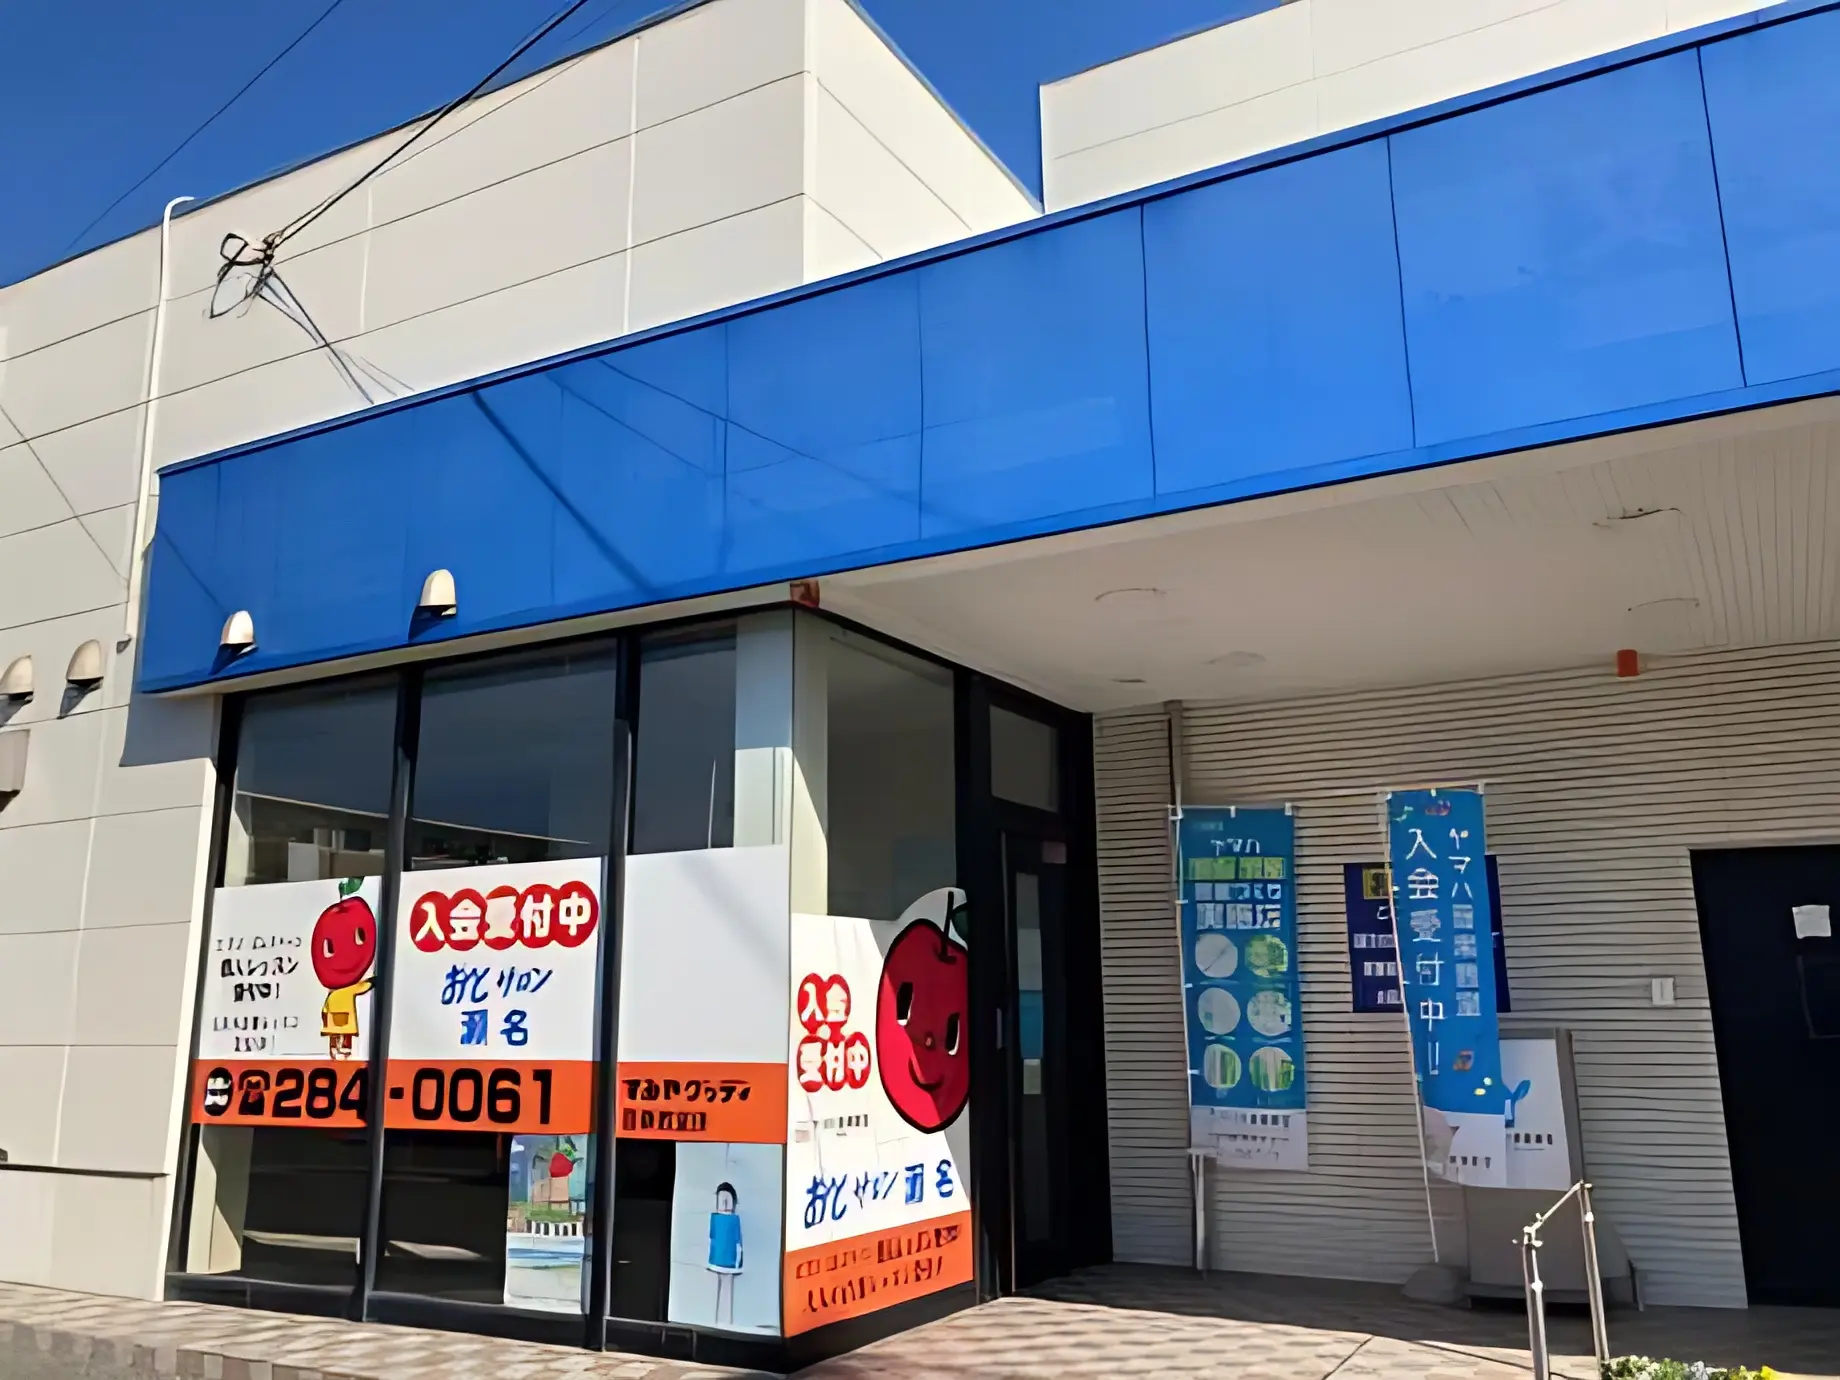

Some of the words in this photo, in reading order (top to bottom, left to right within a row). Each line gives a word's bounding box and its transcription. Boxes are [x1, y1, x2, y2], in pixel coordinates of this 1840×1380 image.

[413, 889, 594, 941] 入会付中
[459, 1008, 528, 1046] 名
